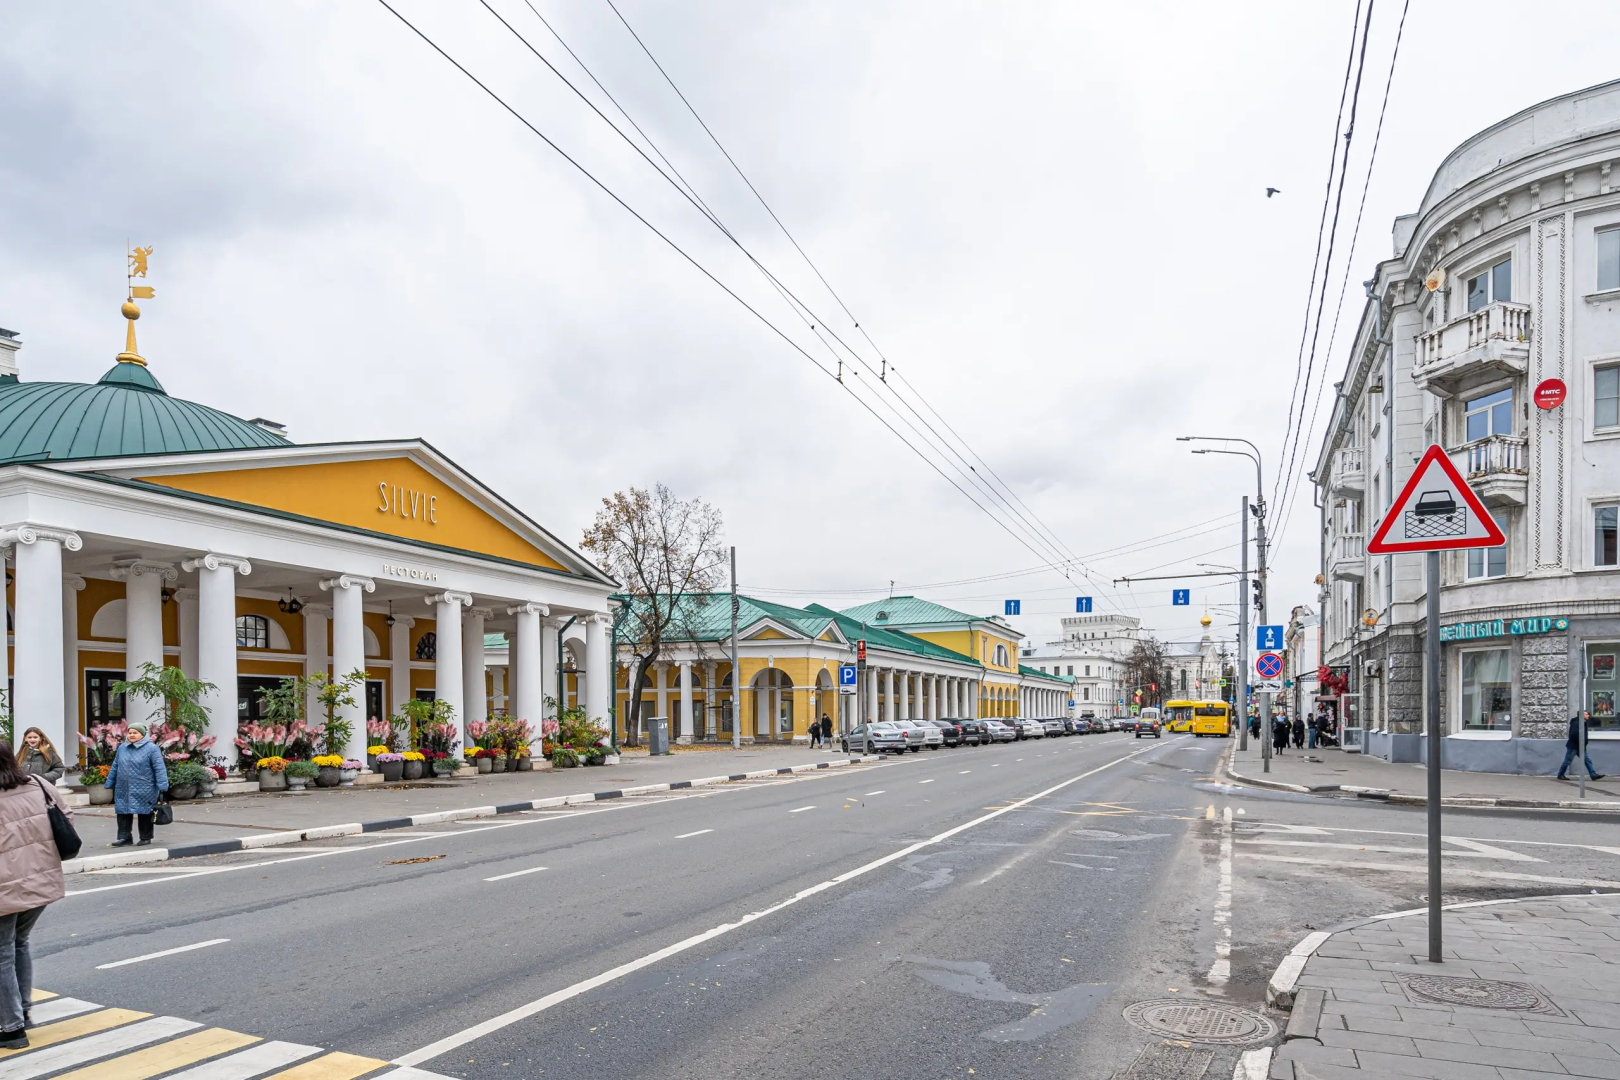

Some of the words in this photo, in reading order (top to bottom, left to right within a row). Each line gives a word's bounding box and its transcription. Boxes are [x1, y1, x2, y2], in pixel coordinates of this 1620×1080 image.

[377, 482, 438, 524] SILVIE
[383, 564, 438, 581] РЕСТОРАН
[1439, 619, 1504, 641] ВЕЙНЫЙ
[1510, 617, 1552, 635] МИР
[844, 668, 854, 683] P
